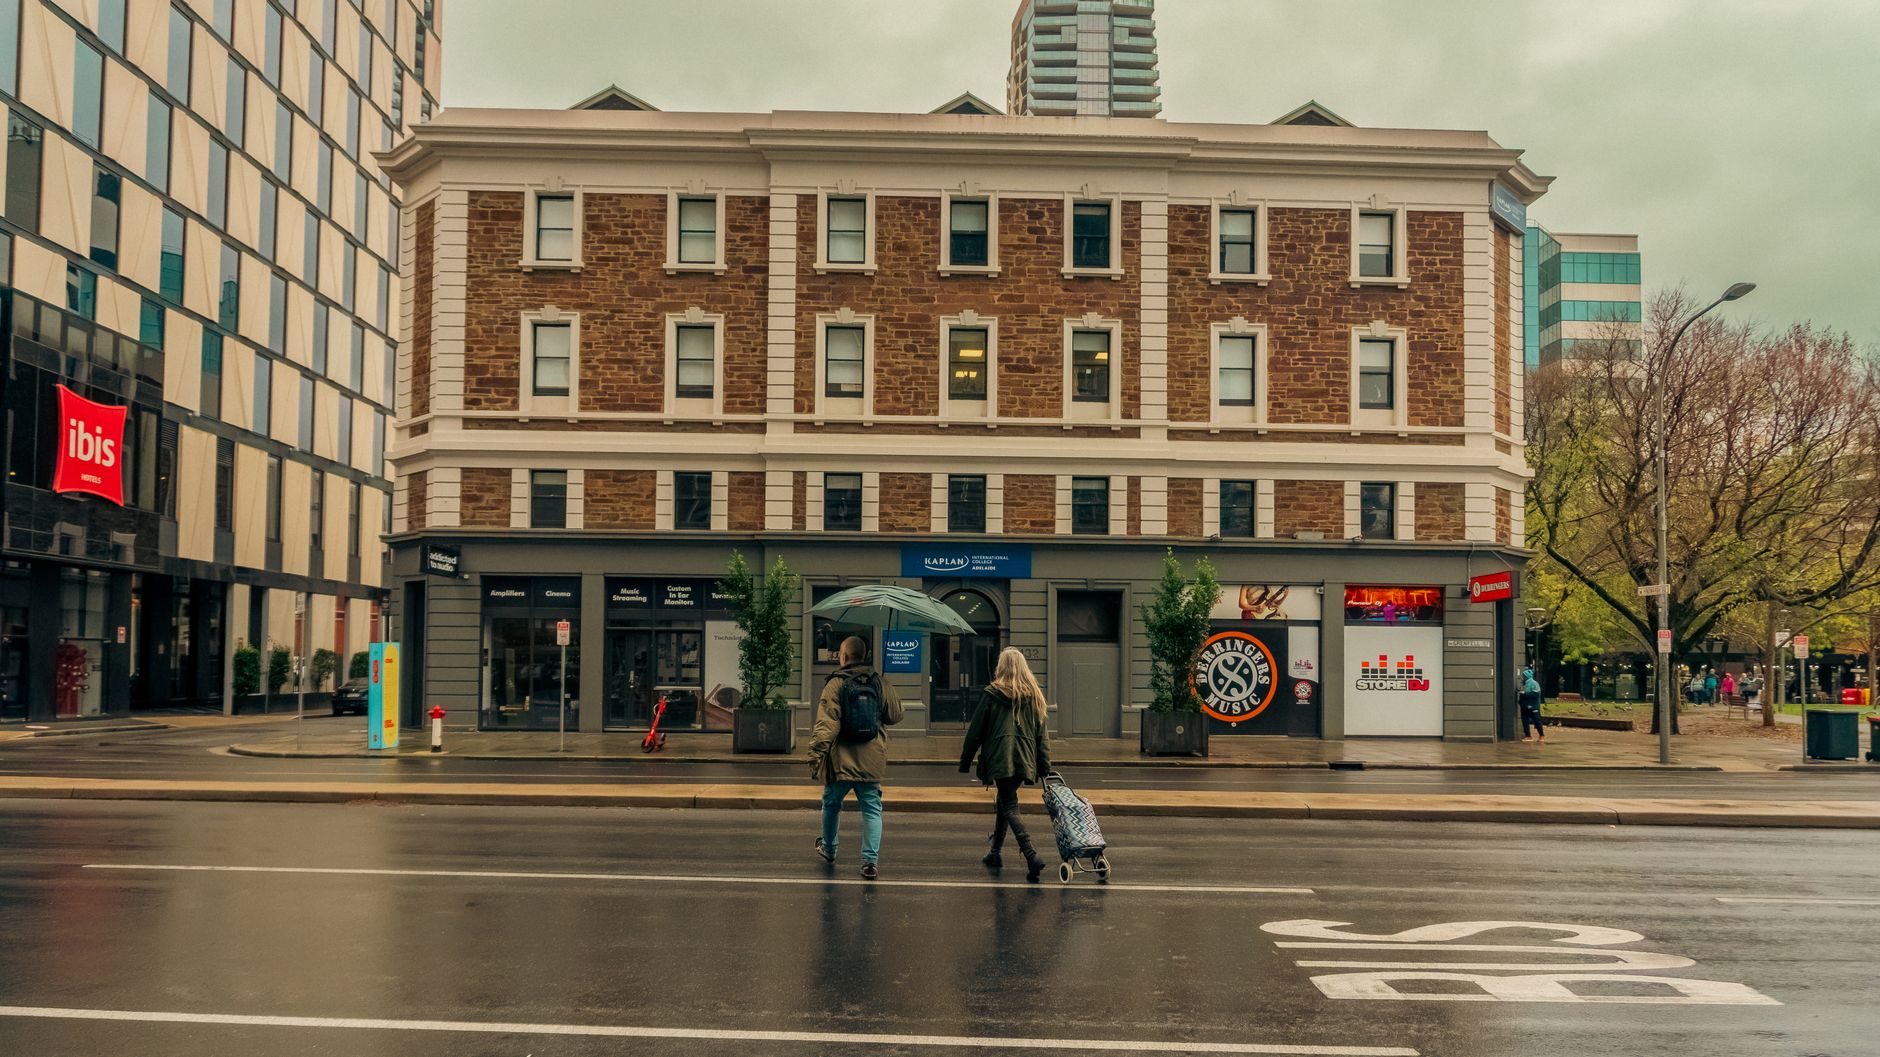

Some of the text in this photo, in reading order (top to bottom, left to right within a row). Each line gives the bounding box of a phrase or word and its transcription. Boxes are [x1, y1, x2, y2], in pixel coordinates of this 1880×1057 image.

[69, 418, 115, 467] ibis
[81, 473, 102, 484] HOTELS
[430, 552, 457, 564] addicted
[924, 557, 964, 565] KAPLAN
[430, 560, 454, 572] to audio
[1481, 580, 1510, 593] DERRINGERS
[490, 590, 525, 598] Amplifiers
[1196, 639, 1270, 685] DERRINGERS
[1356, 679, 1429, 691] STORE DJ
[1205, 693, 1261, 715] MUSIC
[1260, 919, 1784, 1005] BUS
